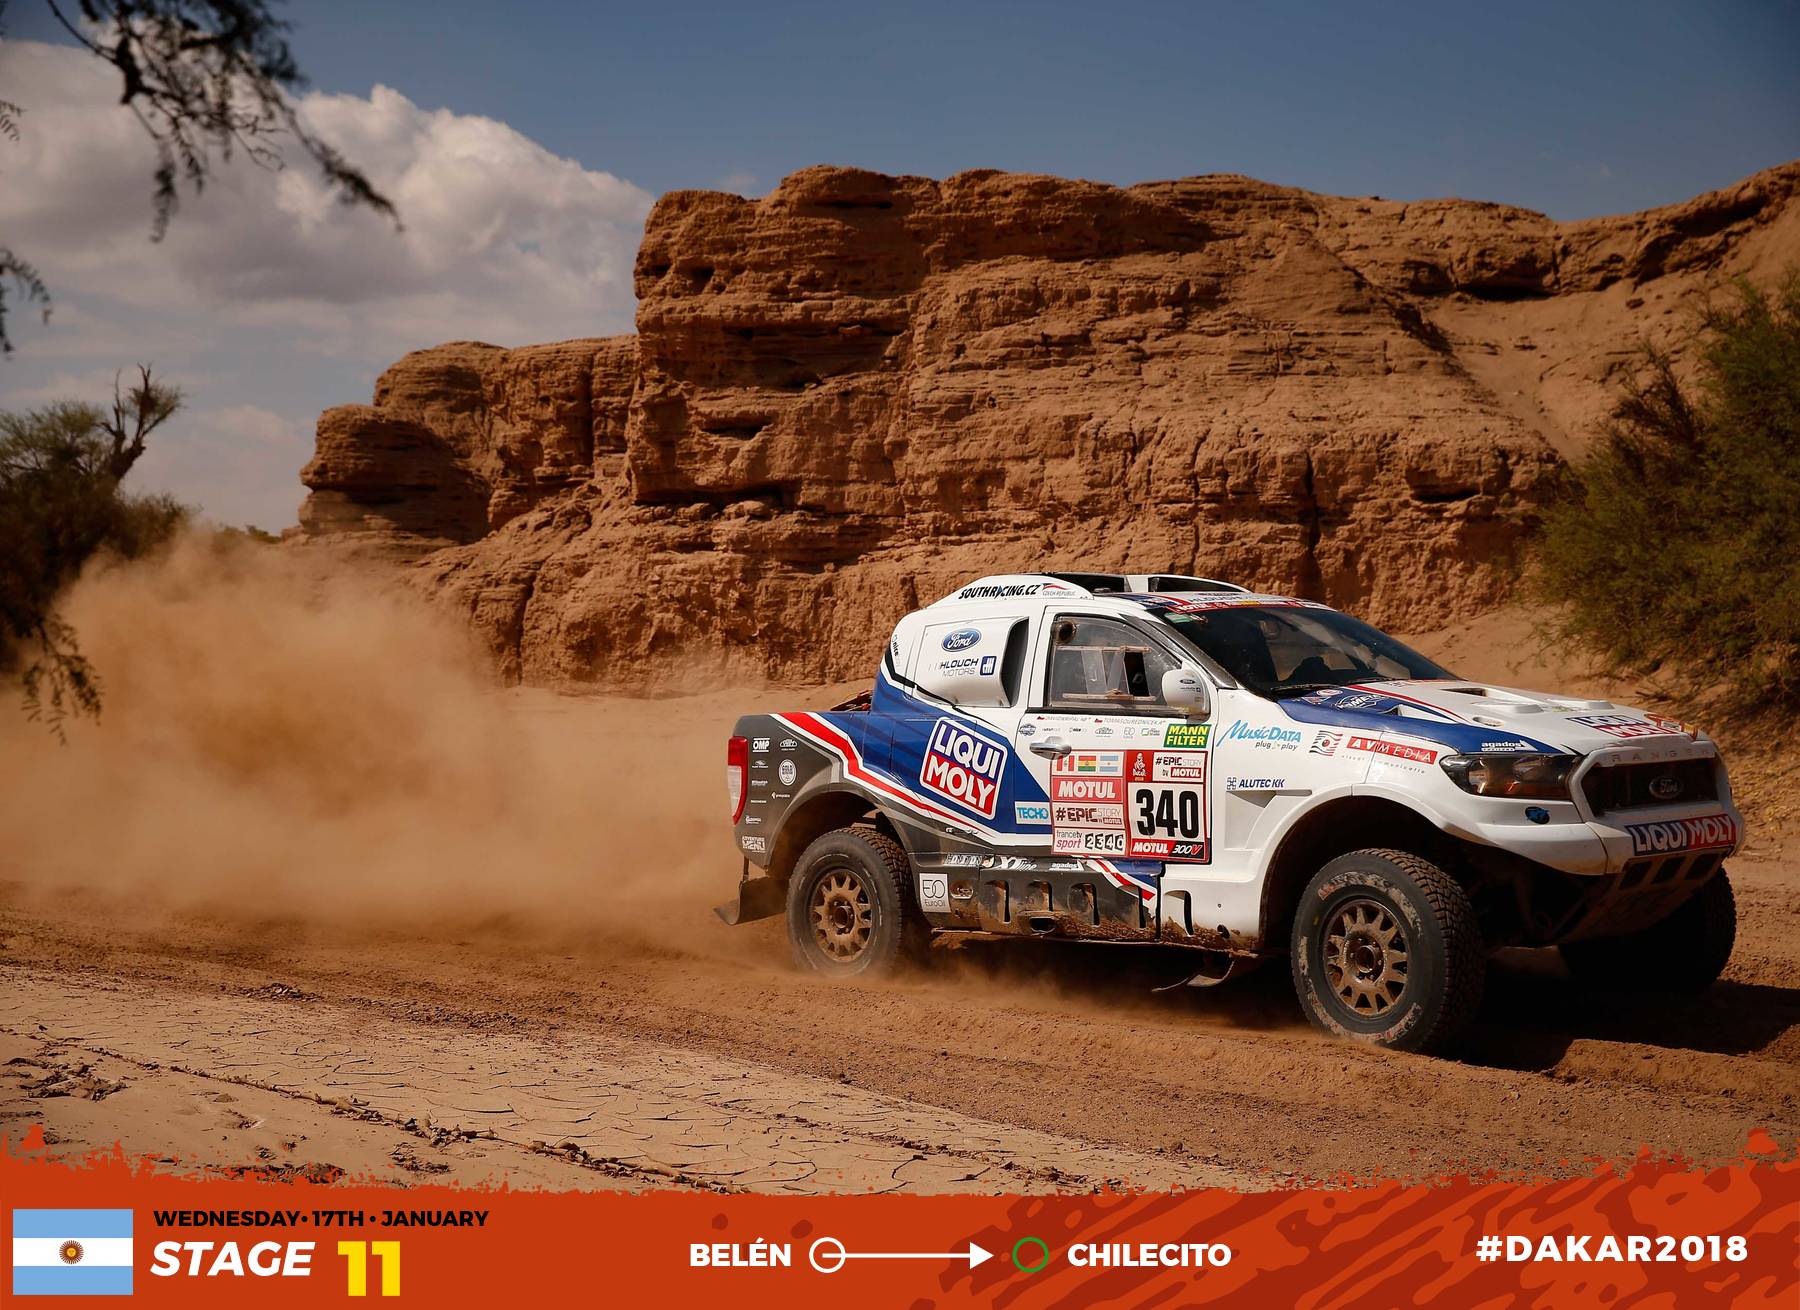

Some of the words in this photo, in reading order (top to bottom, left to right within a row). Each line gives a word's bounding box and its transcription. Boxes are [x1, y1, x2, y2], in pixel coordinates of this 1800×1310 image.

[940, 658, 979, 669] HLOUCH
[942, 667, 976, 677] MOTORS
[1168, 725, 1208, 736] MANN
[752, 741, 770, 750] OMP
[1166, 735, 1206, 746] FILTER
[1255, 740, 1272, 749] plug
[1281, 742, 1298, 751] play
[933, 724, 1000, 778] LIQUI
[1171, 768, 1200, 777] MOTUL
[926, 755, 995, 809] MOLY
[1238, 779, 1271, 788] ALUTEC
[1271, 779, 1286, 788] KK
[1058, 781, 1116, 799] MOTUL
[1016, 807, 1049, 819] TECHO
[1136, 788, 1200, 839] 340
[1629, 822, 1687, 852] LIQUI
[1685, 815, 1732, 845] MOLY
[1056, 839, 1082, 850] sport
[1132, 842, 1169, 854] MOTUL
[1172, 844, 1204, 856] 300V
